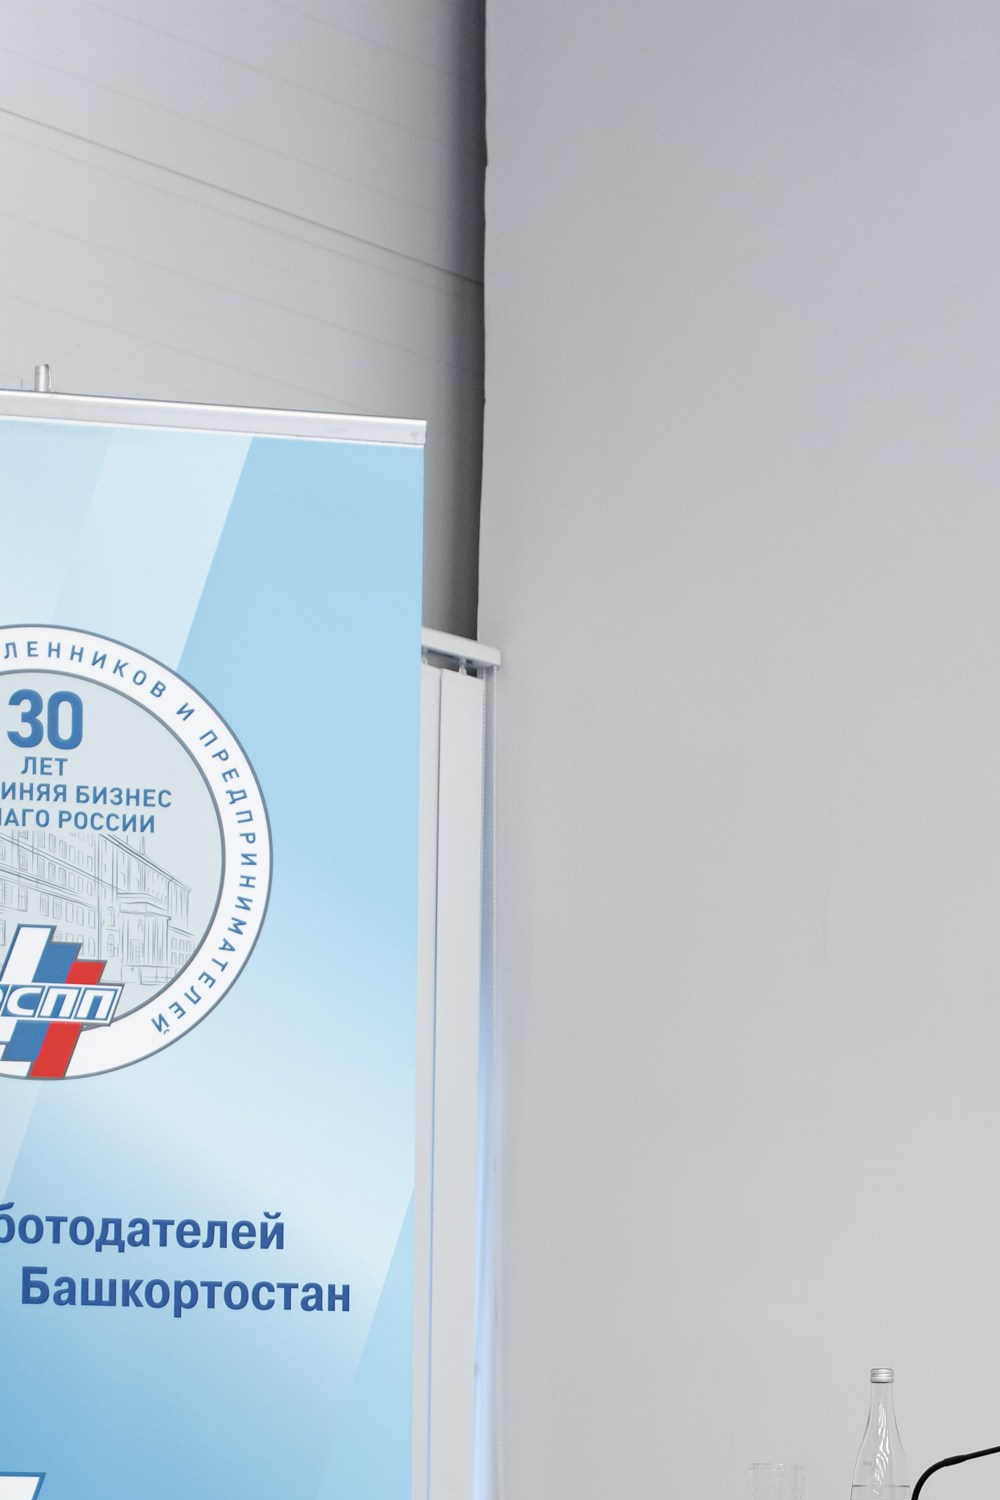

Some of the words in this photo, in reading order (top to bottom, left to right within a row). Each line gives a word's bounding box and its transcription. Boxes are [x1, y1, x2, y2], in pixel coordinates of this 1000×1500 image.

[4, 641, 166, 698] ЛЕННИКОВ
[7, 689, 83, 750] 30
[176, 703, 195, 721] И
[21, 757, 68, 776] ЛЕТ
[0, 807, 50, 828] АГО
[58, 810, 155, 833] РОССИИ
[1, 781, 67, 802] ИНЯЯ
[76, 785, 172, 808] БИЗНЕС
[151, 730, 258, 1034] ПРЕДПРИНИМАТЕЛЕЙ
[0, 1201, 285, 1253] ботодателей
[21, 1266, 350, 1318] Башкортостан
